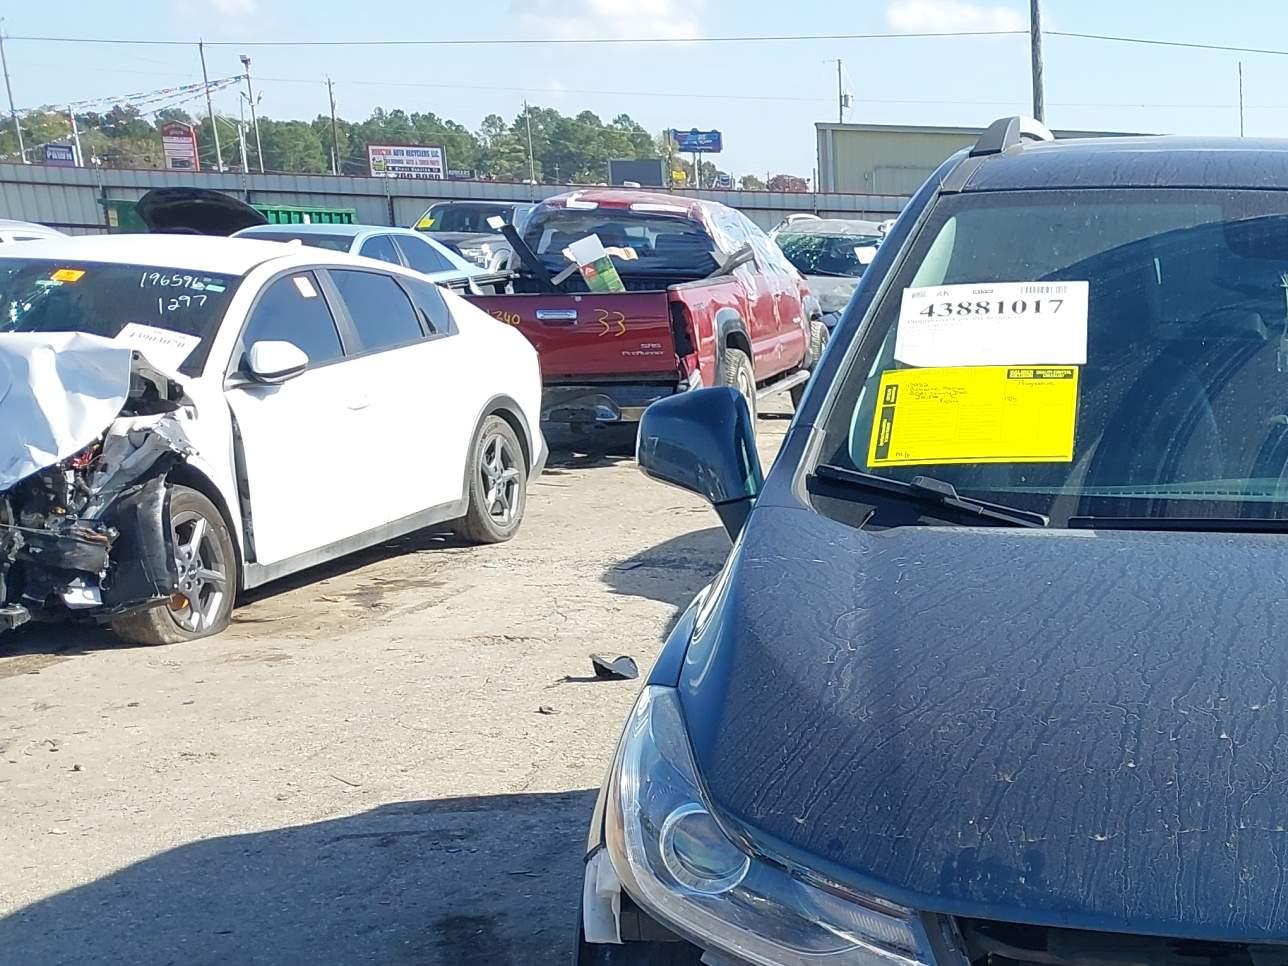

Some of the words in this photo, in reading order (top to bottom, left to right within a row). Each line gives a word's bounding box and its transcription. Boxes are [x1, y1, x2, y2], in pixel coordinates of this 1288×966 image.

[158, 294, 208, 314] 1297
[919, 299, 1064, 318] 43881017
[592, 308, 627, 337] 33
